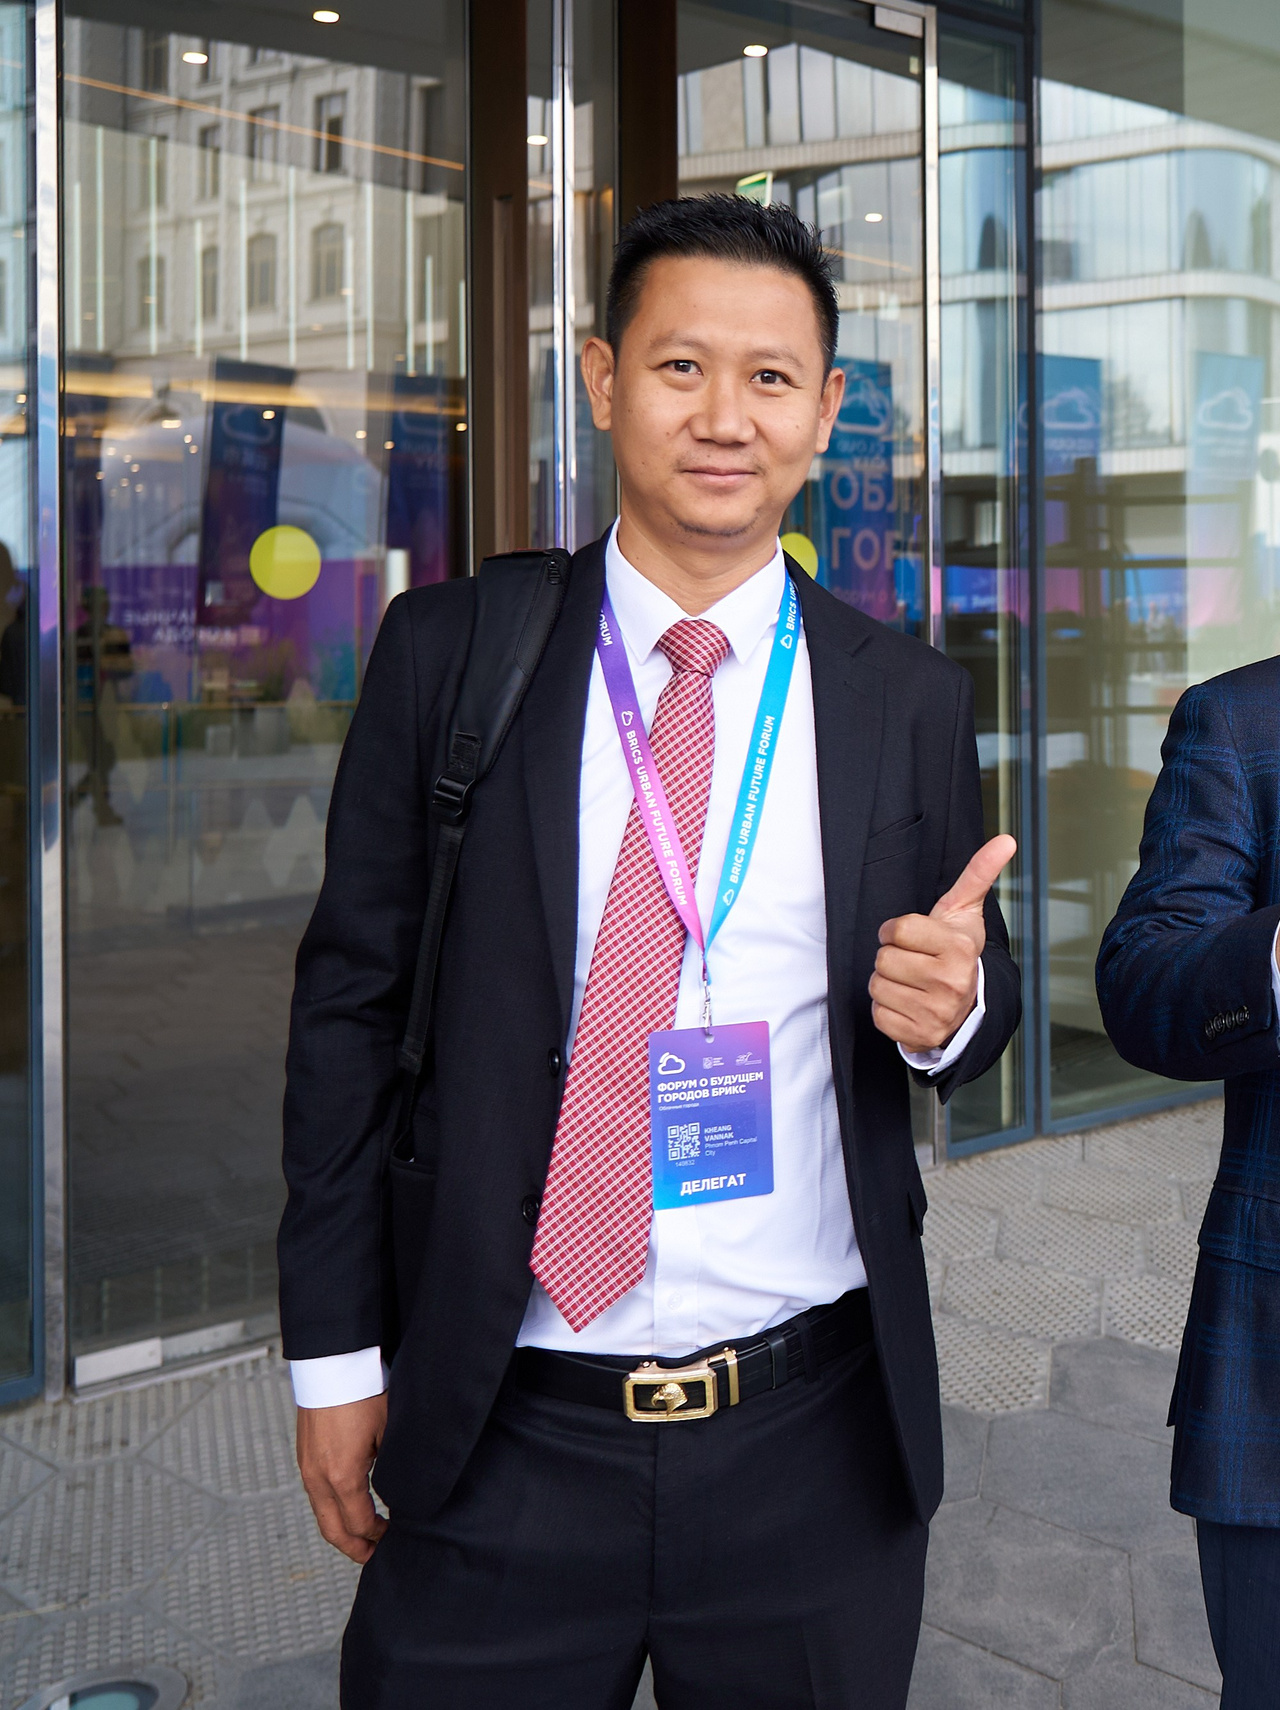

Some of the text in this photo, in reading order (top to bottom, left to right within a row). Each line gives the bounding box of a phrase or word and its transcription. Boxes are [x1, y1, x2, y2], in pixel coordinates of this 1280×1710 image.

[599, 609, 613, 646] ORUM
[786, 601, 797, 631] BRICS
[730, 716, 775, 884] BRICS URBAN FUTURE FORUM
[626, 730, 688, 906] BRICS URBAN FUTURE FORUM
[657, 1072, 764, 1092] ФОРУМ О БУДУЩЕМ
[658, 1084, 746, 1104] ГОРОДОВ БРИКС
[704, 1124, 732, 1134] KHEANG
[704, 1132, 734, 1142] VANNAK
[680, 1173, 746, 1196] ДЕЛЕГАТ
